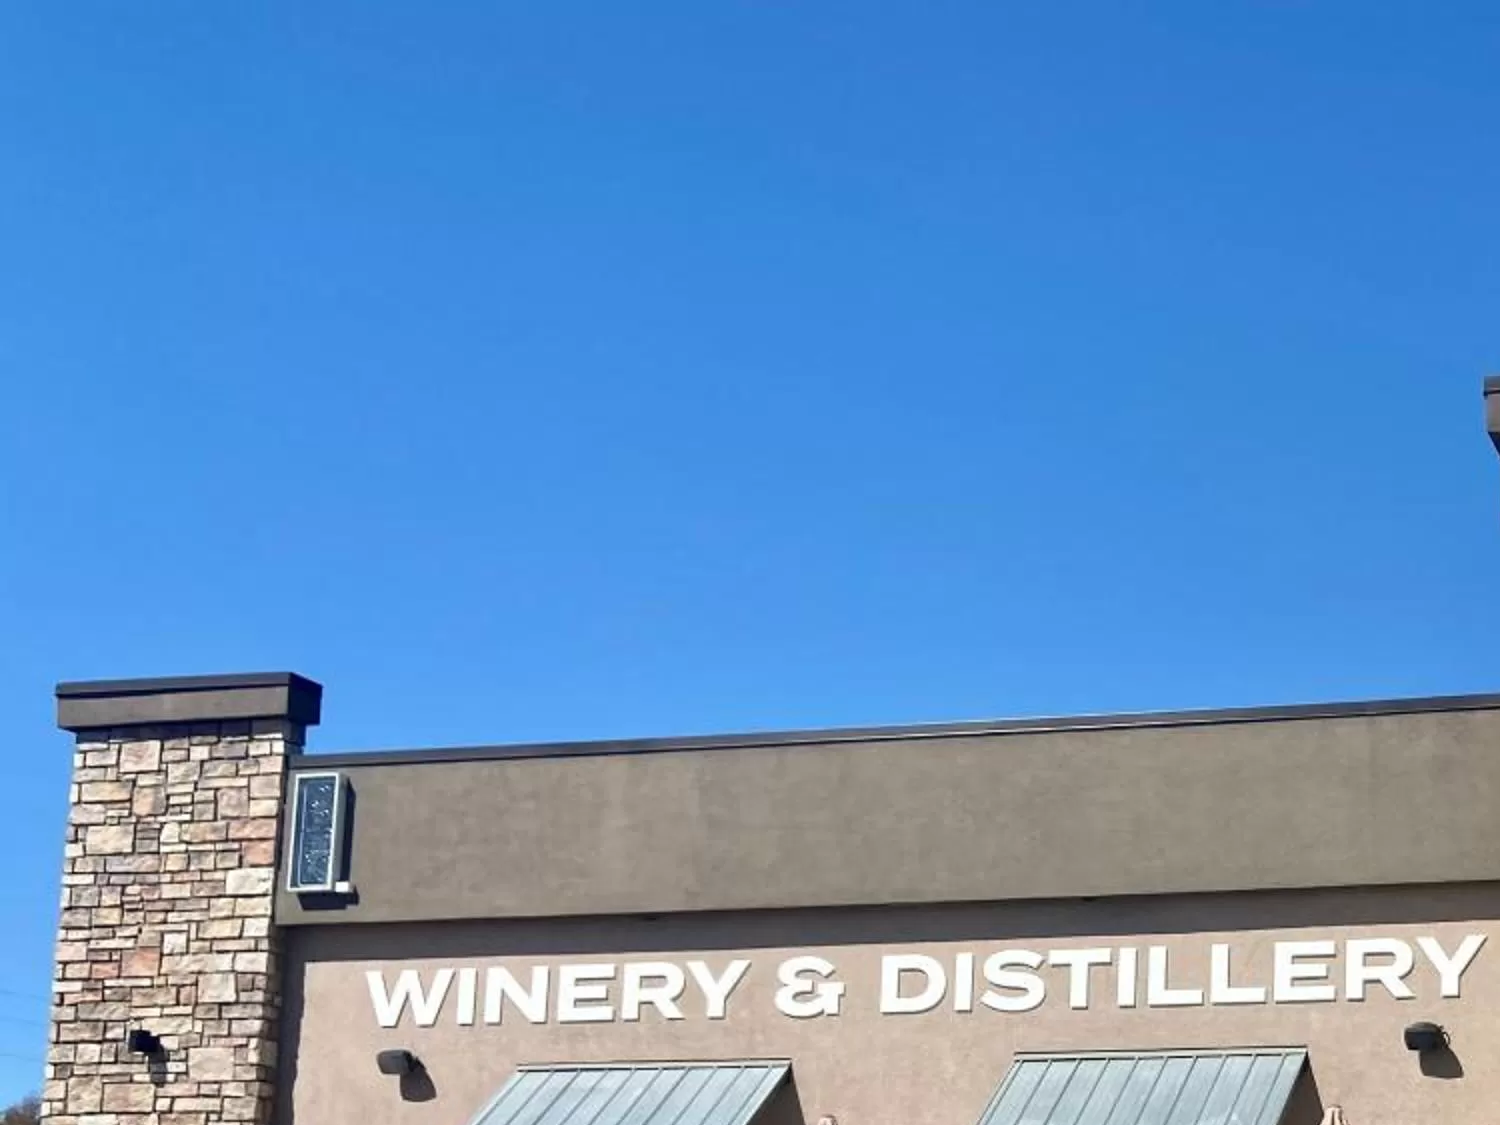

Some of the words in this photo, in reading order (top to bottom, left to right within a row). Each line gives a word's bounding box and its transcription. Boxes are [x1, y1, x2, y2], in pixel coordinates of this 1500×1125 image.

[365, 958, 752, 1027] WINERY
[773, 955, 846, 1020] &
[879, 934, 1488, 1015] DISTILLERY
